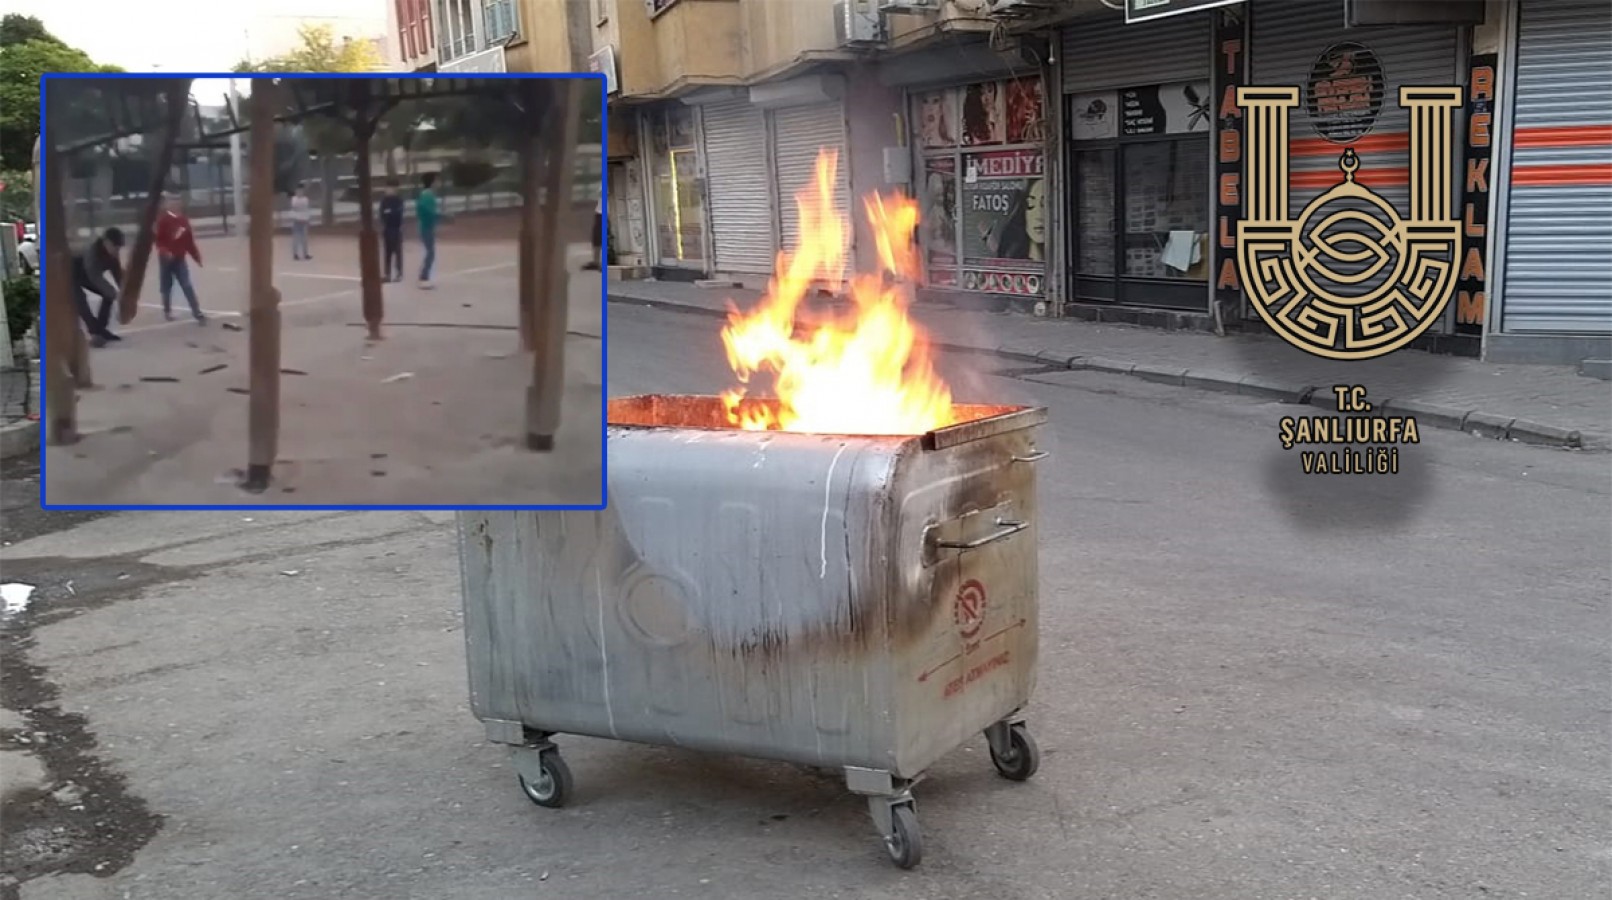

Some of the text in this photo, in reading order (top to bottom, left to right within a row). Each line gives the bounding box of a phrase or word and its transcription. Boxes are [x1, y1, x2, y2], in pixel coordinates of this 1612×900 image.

[973, 194, 1010, 216] FATOŞ
[1217, 40, 1241, 290] TABELA
[1457, 66, 1494, 324] REKLAM
